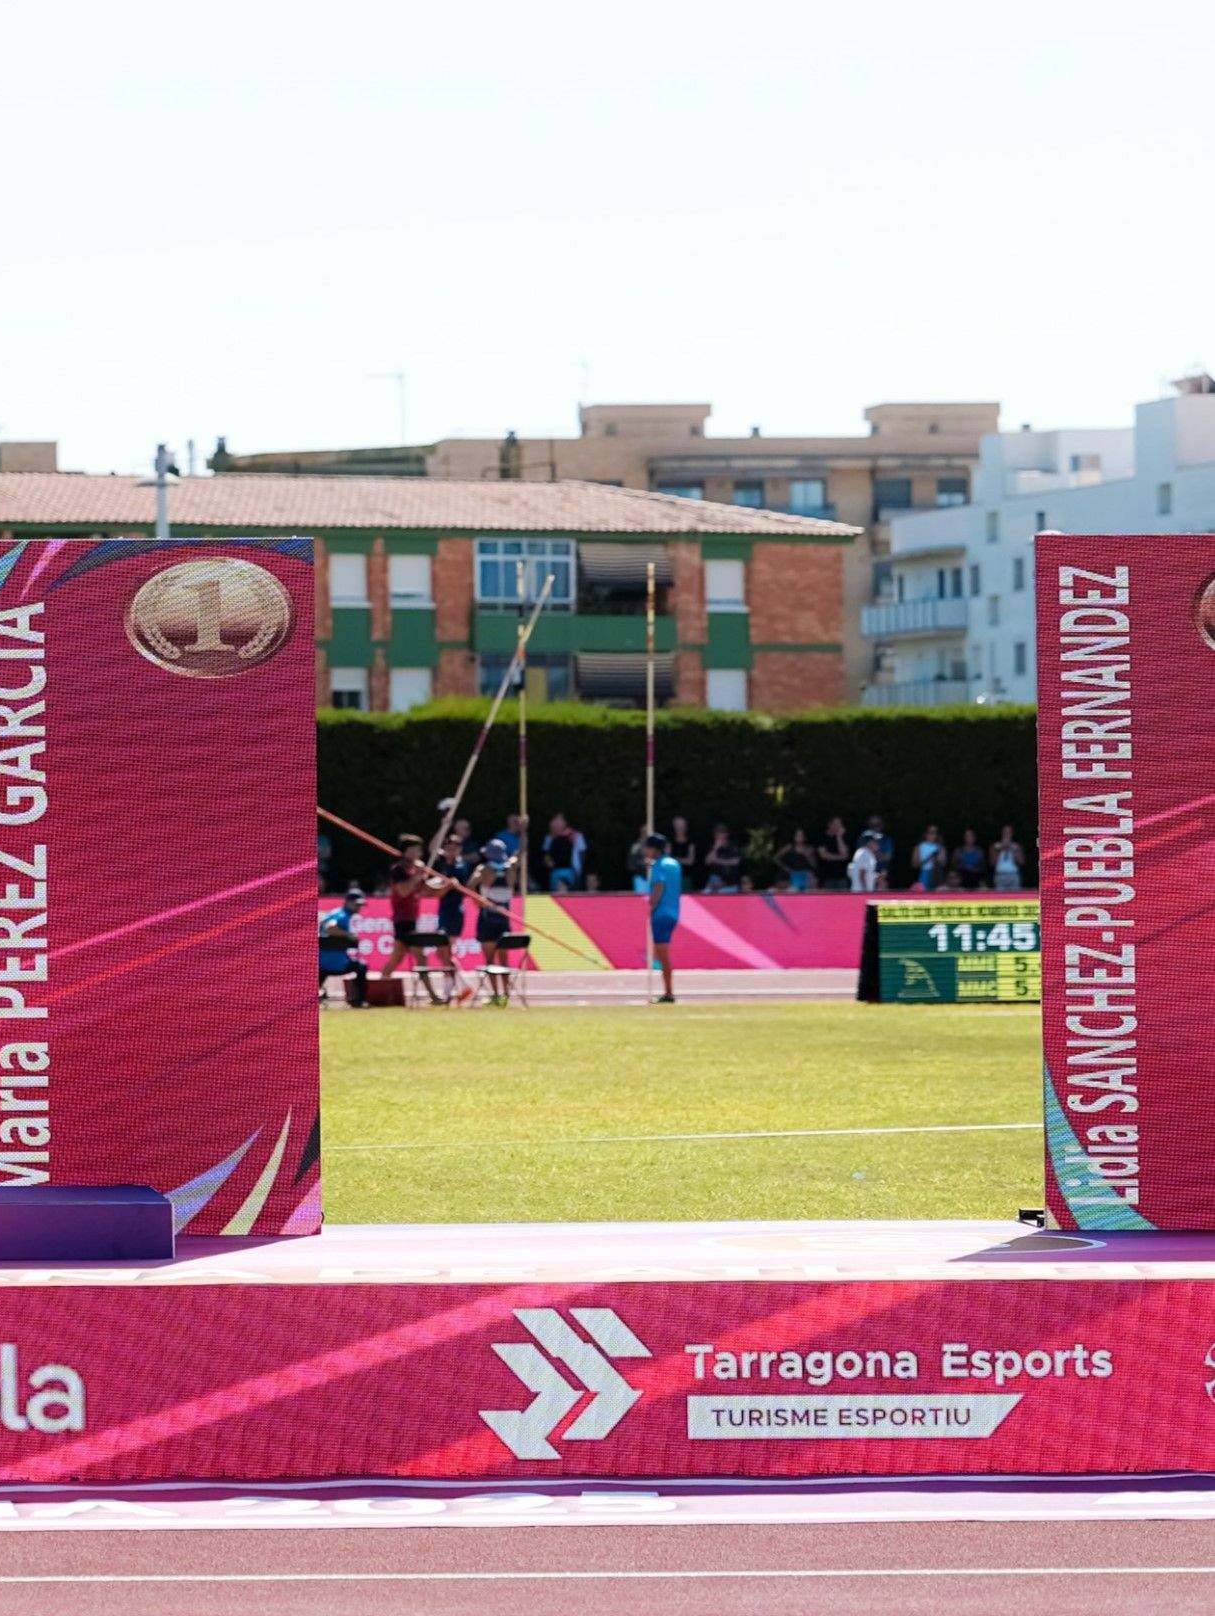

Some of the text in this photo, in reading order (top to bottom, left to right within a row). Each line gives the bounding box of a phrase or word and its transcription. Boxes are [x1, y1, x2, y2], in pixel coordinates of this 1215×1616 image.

[1058, 566, 1133, 779] FERNANDEZ
[927, 922, 1036, 952] 11:45
[1064, 1124, 1140, 1205] Lidia
[685, 1343, 1114, 1386] Tarragona Esports
[711, 1407, 971, 1428] TURISME ESPORTIU
[221, 1490, 679, 1517] 2025
